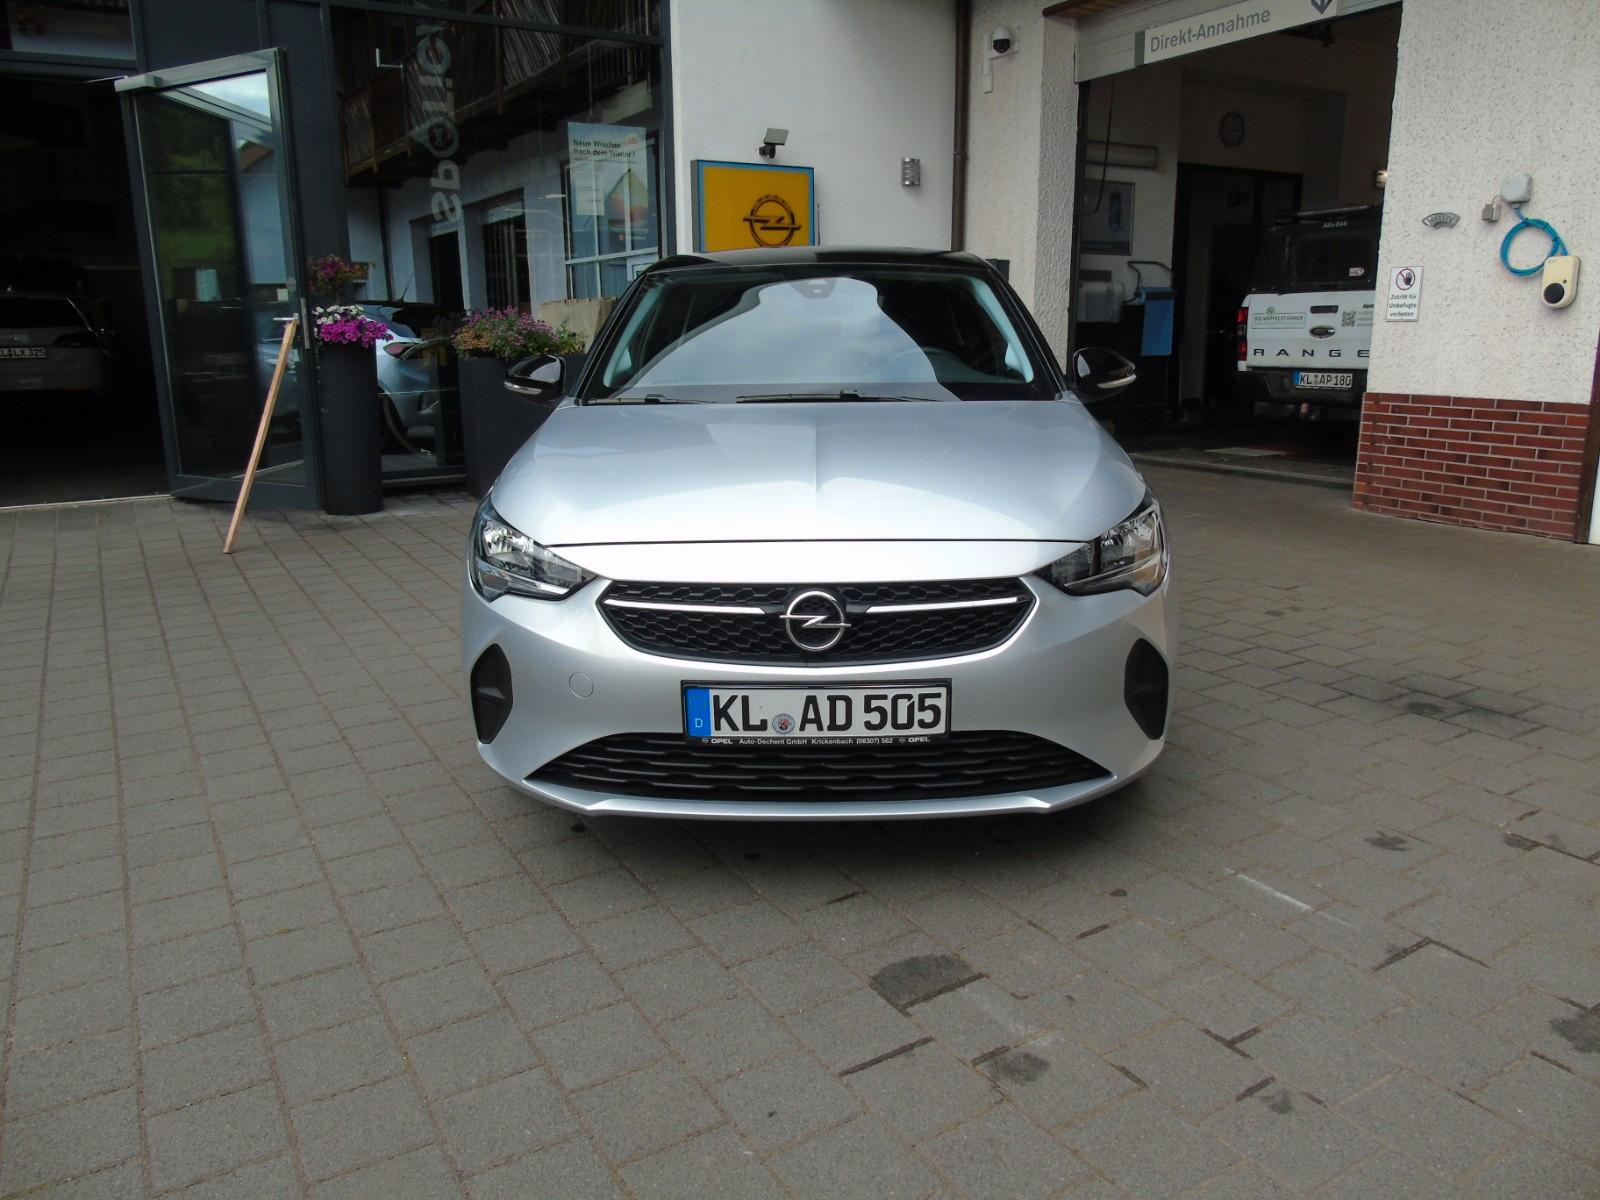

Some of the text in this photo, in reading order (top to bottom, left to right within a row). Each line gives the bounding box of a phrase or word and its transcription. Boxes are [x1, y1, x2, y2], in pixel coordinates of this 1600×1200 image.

[1150, 9, 1270, 53] Direkt-Annahme
[573, 139, 592, 147] Neue
[1300, 373, 1312, 384] KL
[695, 692, 942, 732] D KL AD 505
[739, 737, 785, 745] Auto-Dechent
[908, 735, 931, 743] OPEL
